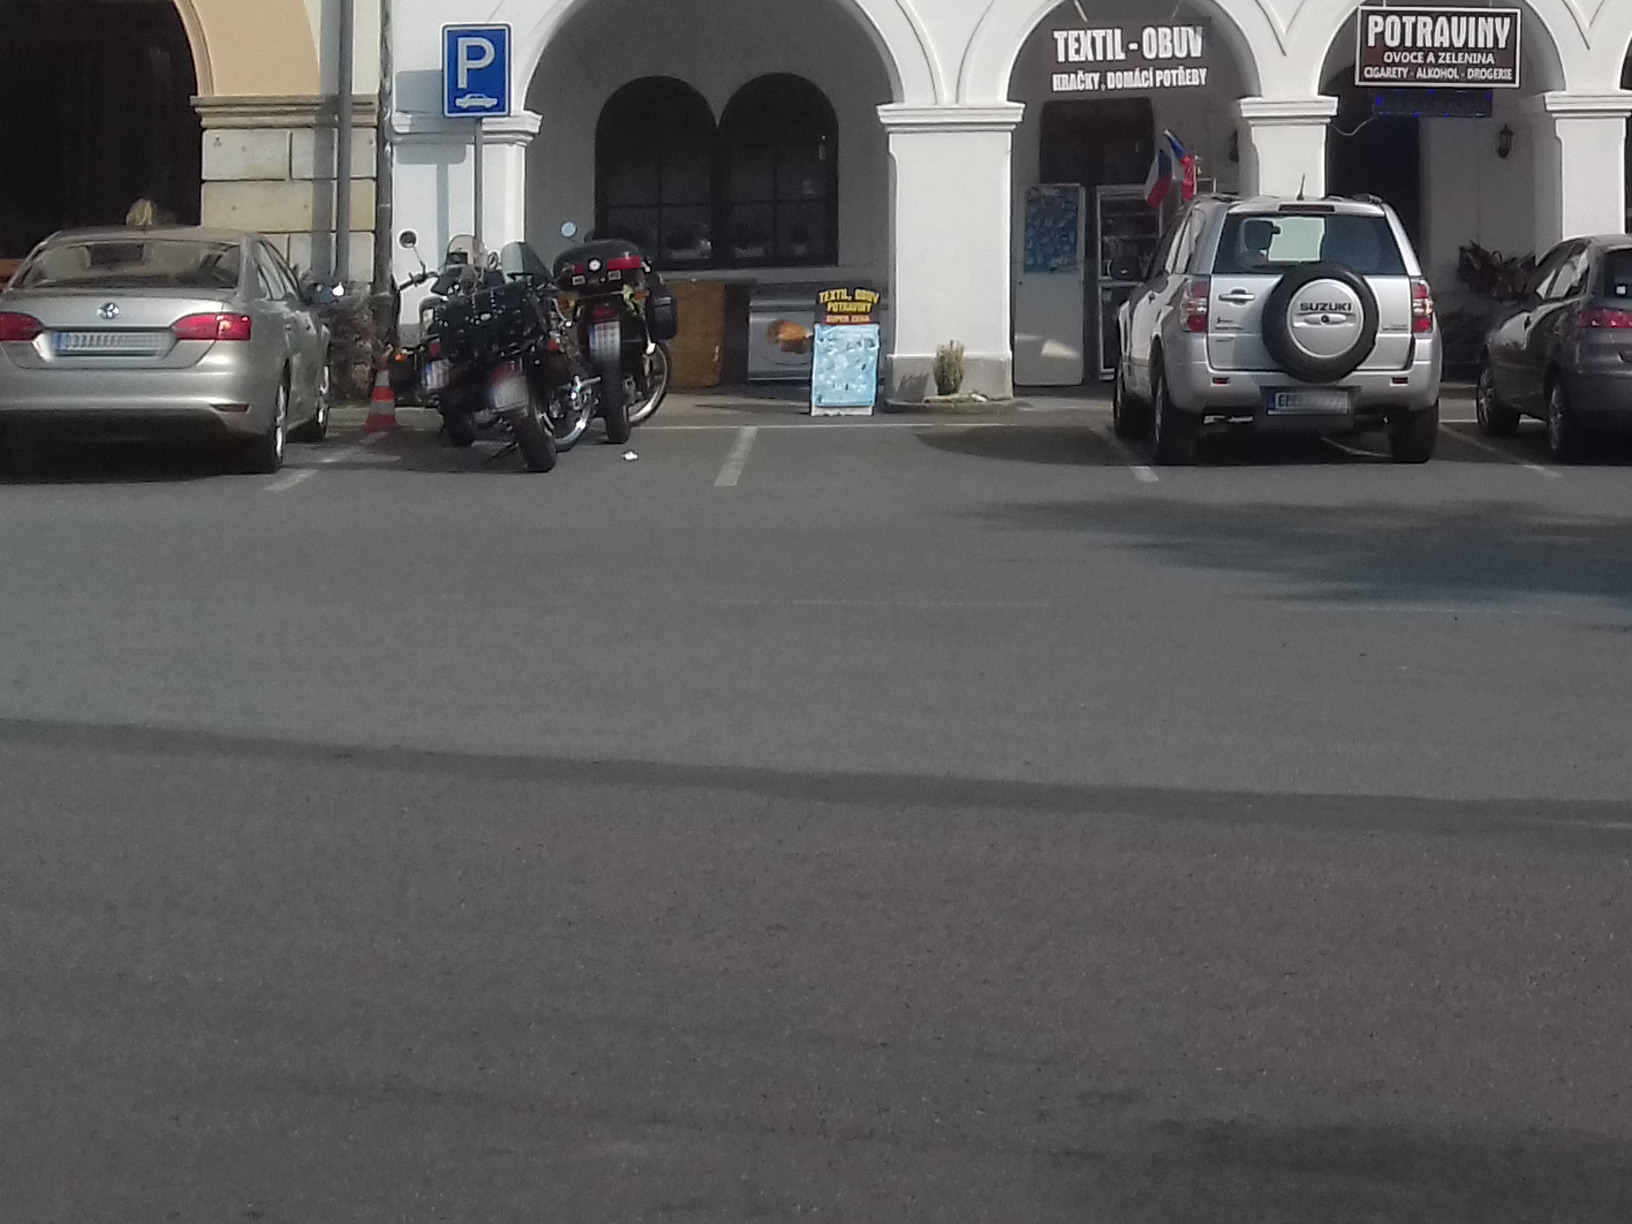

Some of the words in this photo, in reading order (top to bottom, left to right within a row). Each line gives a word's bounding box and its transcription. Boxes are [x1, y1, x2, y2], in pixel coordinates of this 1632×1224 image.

[1367, 15, 1511, 48] POTRAVINY
[1052, 28, 1126, 63] TEXTIL
[1142, 26, 1204, 60] OBUV
[457, 37, 496, 89] P
[1383, 52, 1424, 64] OVOCE
[1426, 52, 1436, 64] A
[1438, 52, 1496, 65] ZELENINA
[1106, 67, 1153, 90] DOMÁCÍ
[1155, 65, 1208, 87] POTŘEBY
[1363, 66, 1410, 79] CIGARETY
[1416, 67, 1460, 79] ALKOHOL
[1467, 68, 1513, 80] DROGERIE
[1300, 302, 1352, 311] SUZUKI
